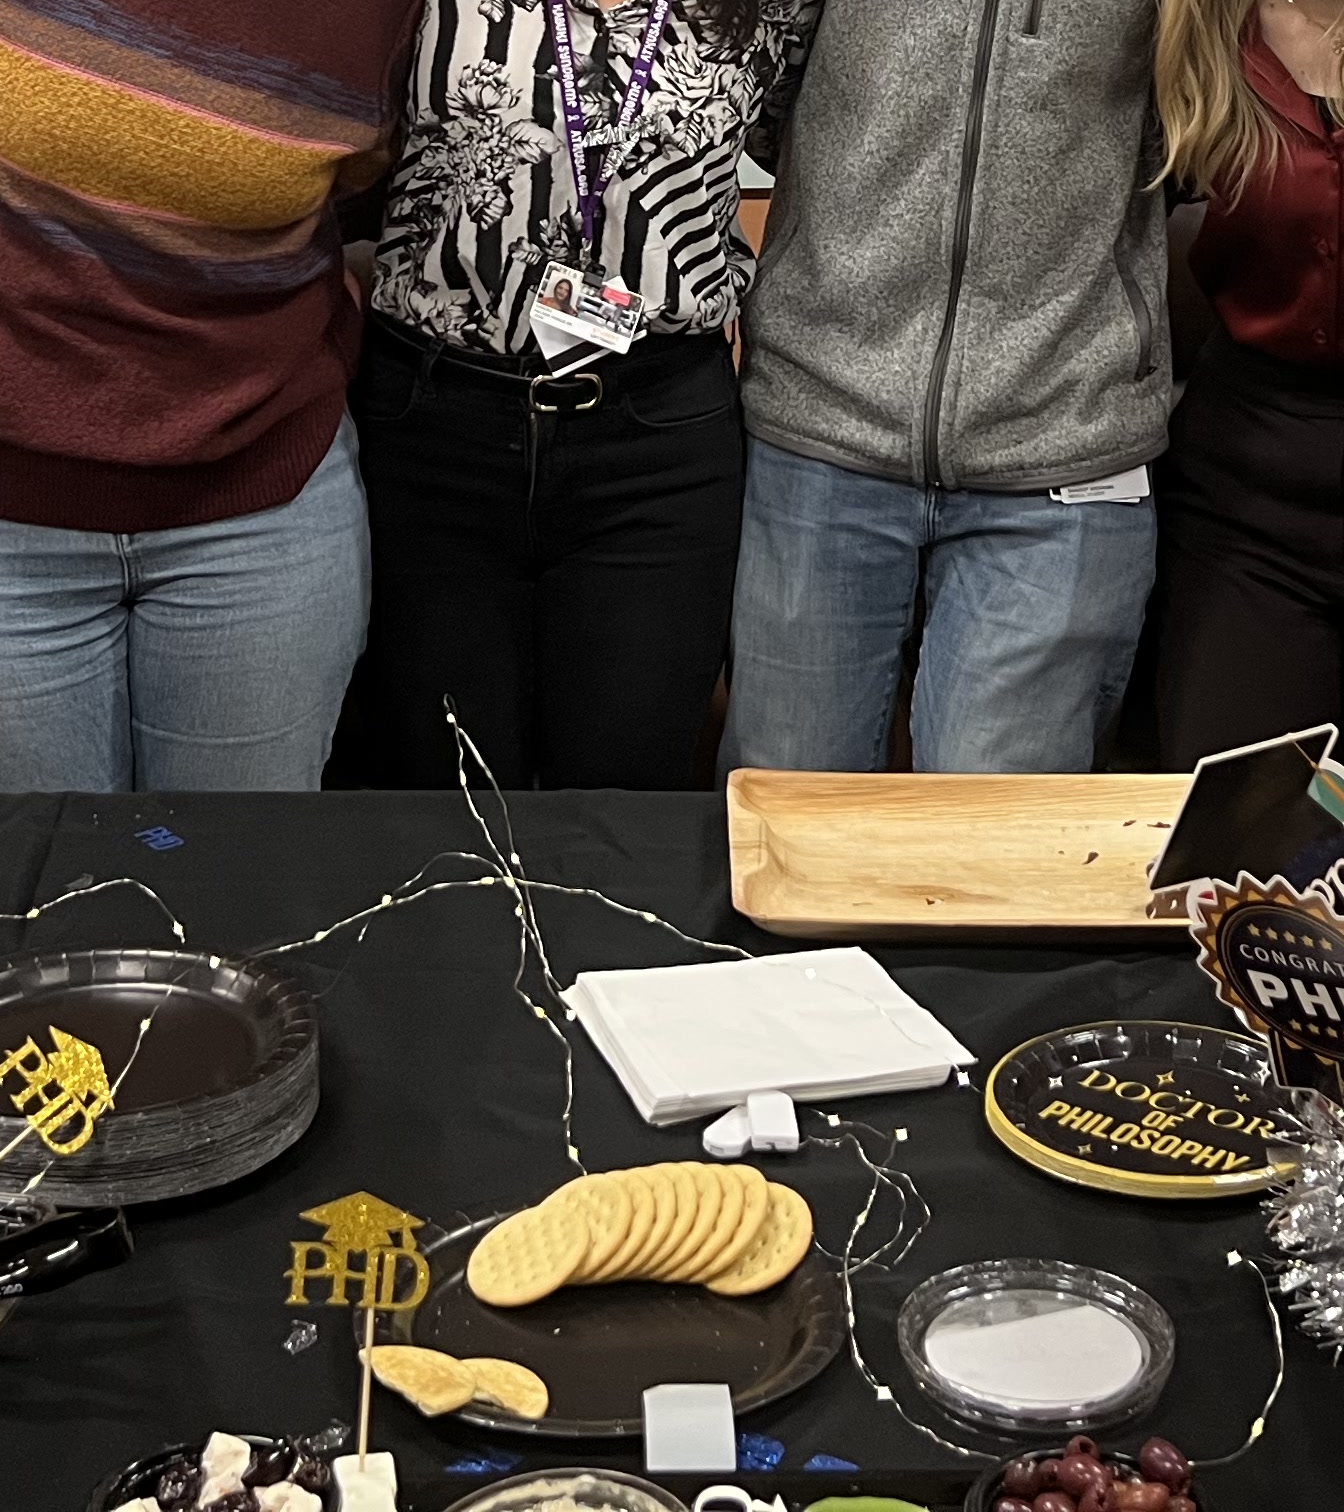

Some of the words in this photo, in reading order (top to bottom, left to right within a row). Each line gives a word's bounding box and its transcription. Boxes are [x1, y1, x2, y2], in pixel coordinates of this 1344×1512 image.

[1037, 1100, 1252, 1172] PHILOSOPHY
[1076, 1068, 1287, 1140] DOCTOR
[1140, 1110, 1185, 1132] OF
[282, 1240, 431, 1310] PHD
